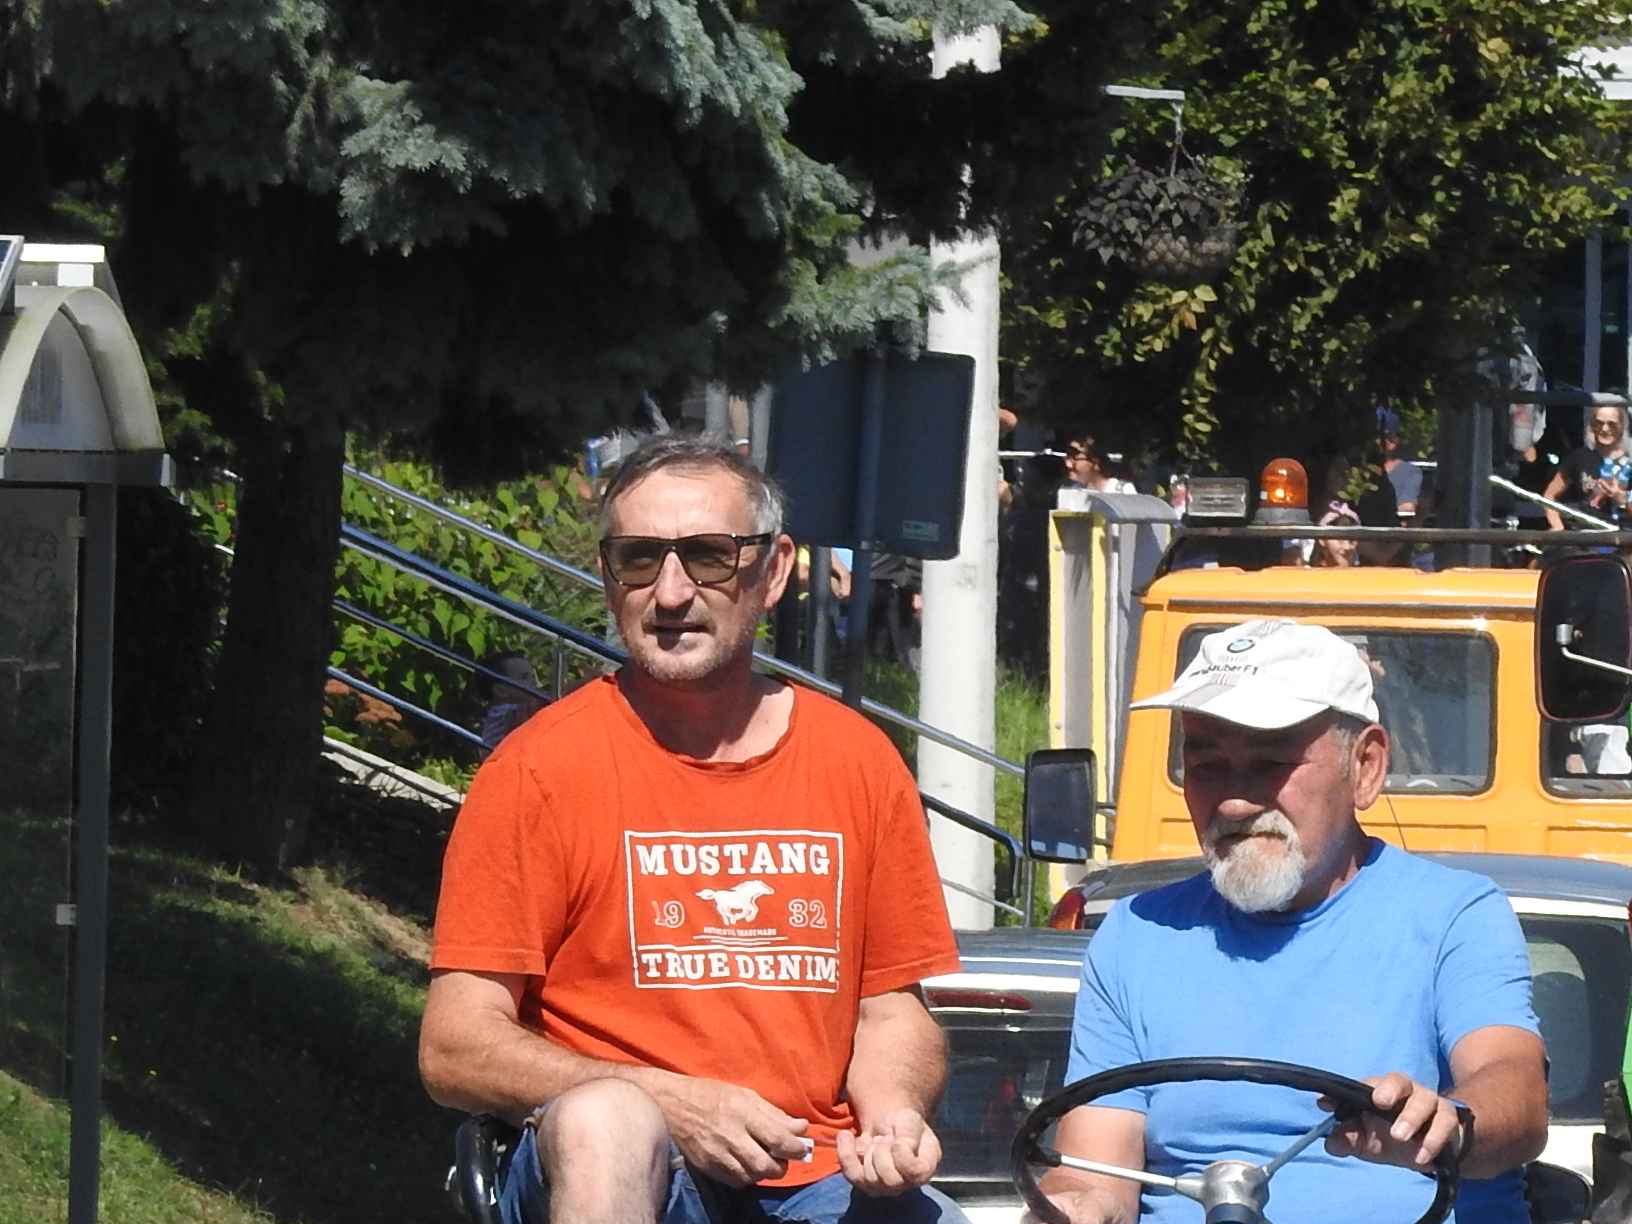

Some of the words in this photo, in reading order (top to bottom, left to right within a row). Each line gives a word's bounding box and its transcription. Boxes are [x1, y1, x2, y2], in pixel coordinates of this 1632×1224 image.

[635, 841, 830, 876] MUSTANG
[651, 899, 685, 928] 19
[788, 898, 828, 929] 32
[640, 952, 730, 979] TRUE
[734, 954, 839, 983] DENIM
